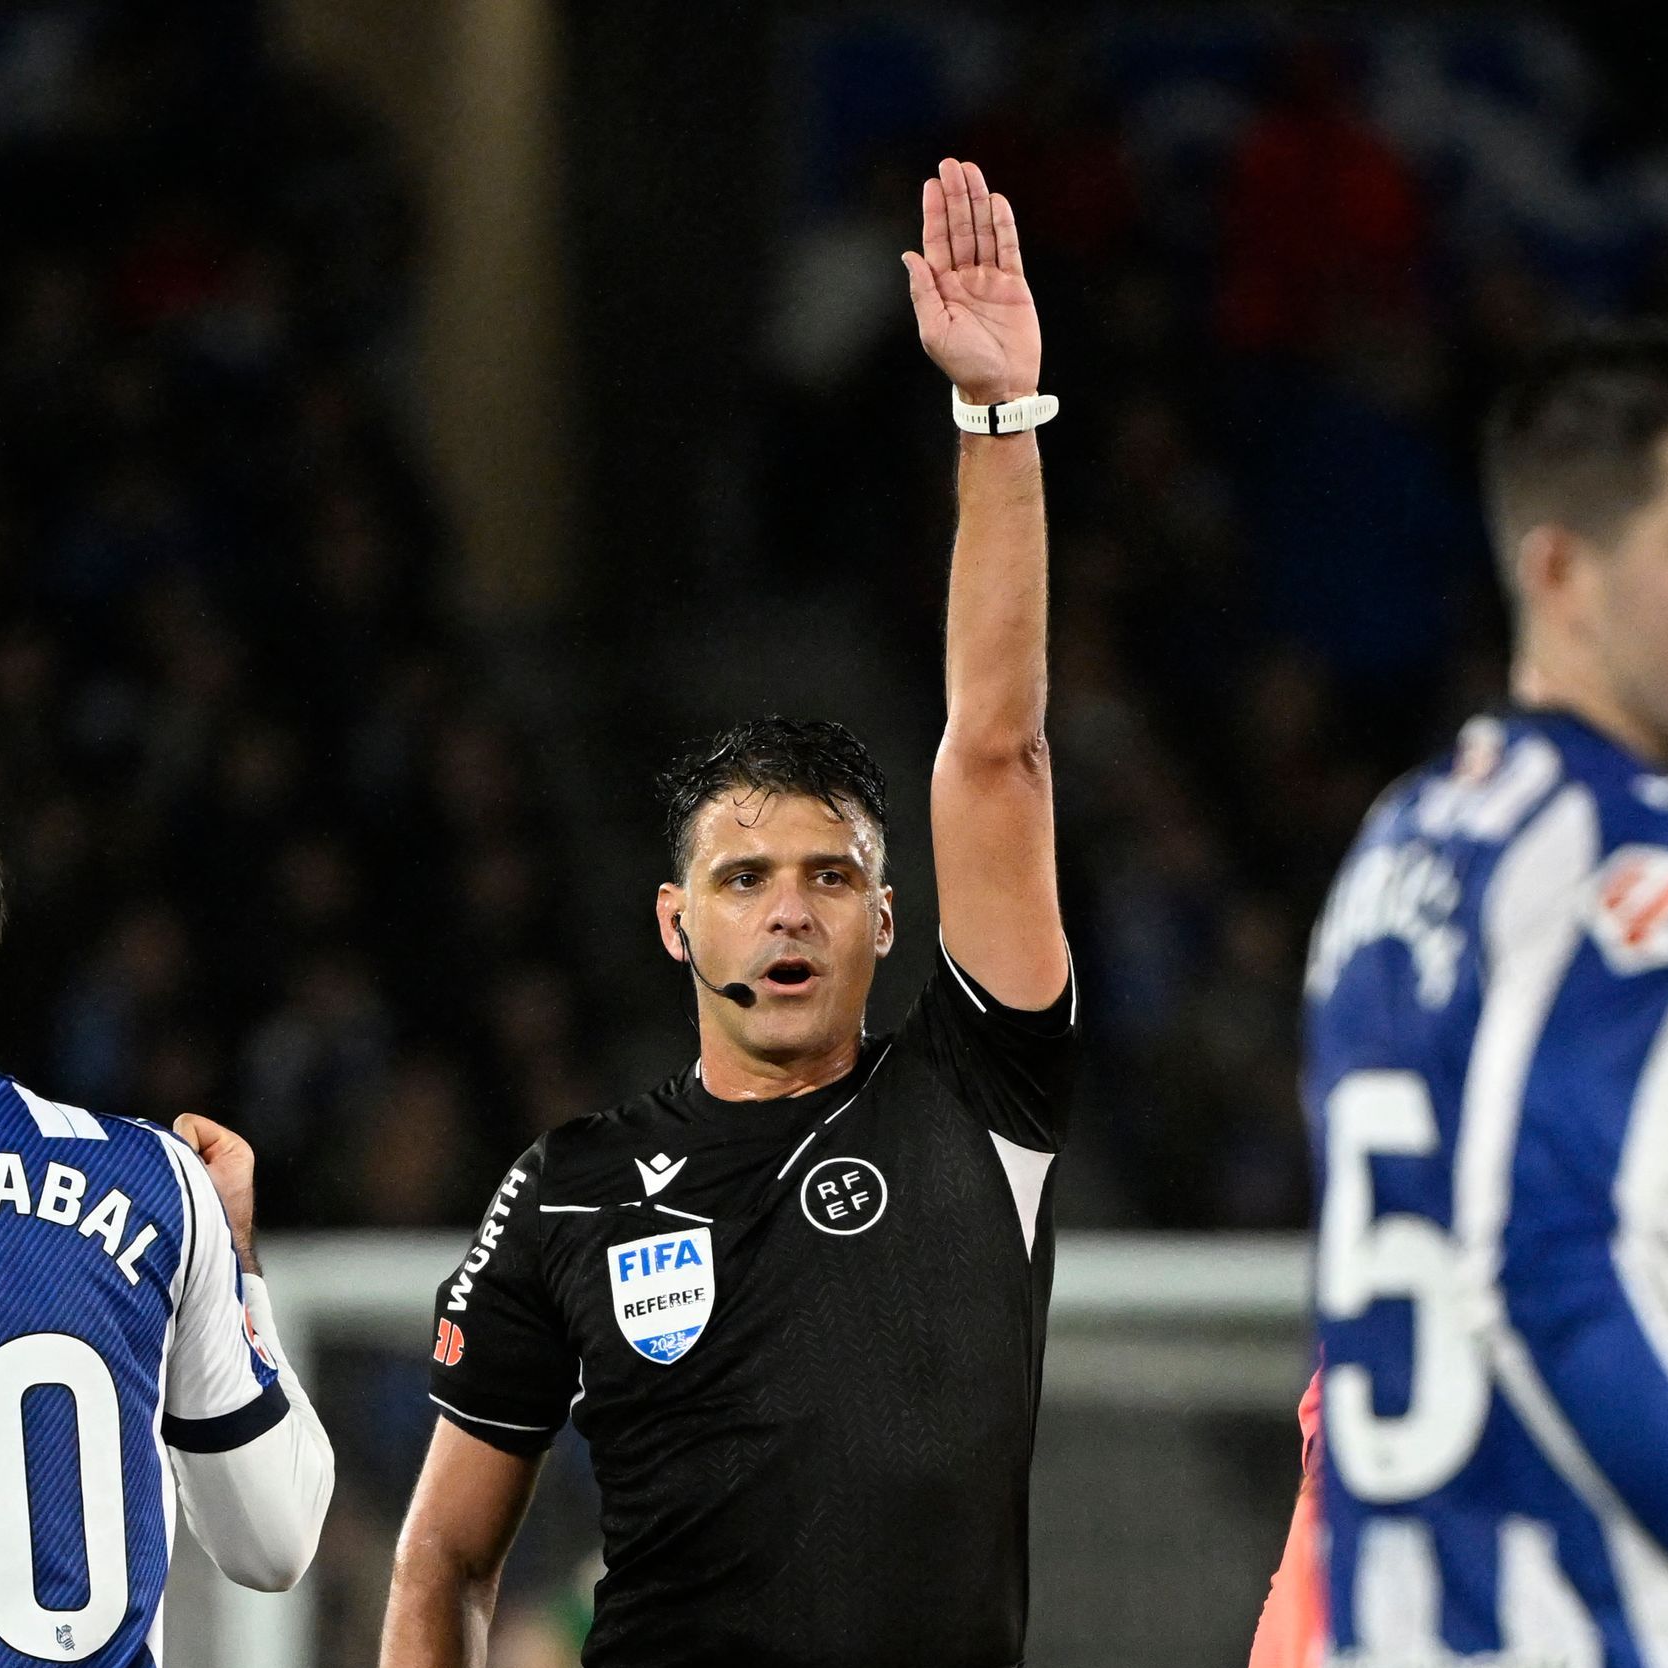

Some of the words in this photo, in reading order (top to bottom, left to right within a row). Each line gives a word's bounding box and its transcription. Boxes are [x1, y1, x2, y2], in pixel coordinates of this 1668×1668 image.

[447, 1168, 527, 1311] WÜRTH
[618, 1239, 703, 1282] FIFA
[1318, 1069, 1494, 1500] 5
[624, 1287, 706, 1319] REFEREE
